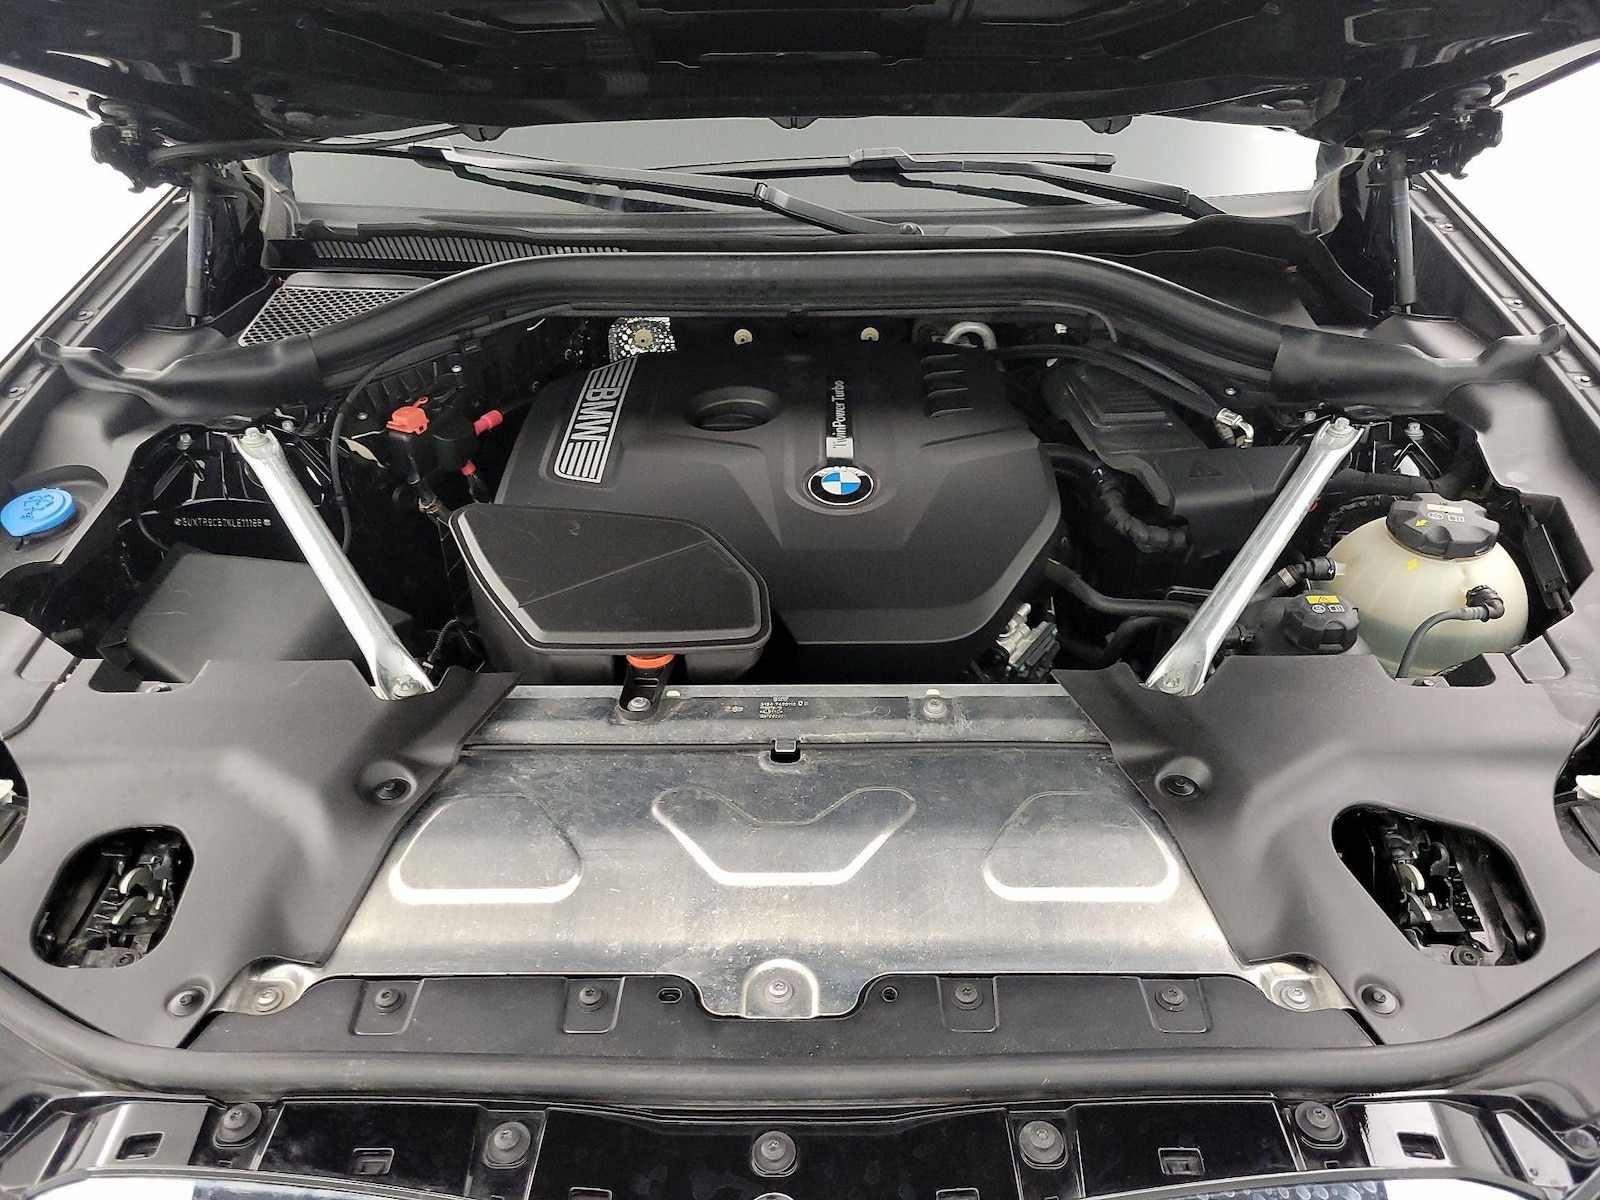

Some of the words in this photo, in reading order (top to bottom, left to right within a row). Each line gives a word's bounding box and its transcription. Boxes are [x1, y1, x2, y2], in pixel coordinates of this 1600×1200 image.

[570, 387, 621, 441] BMW
[831, 380, 845, 402] Turbo
[832, 402, 847, 449] TwinPower
